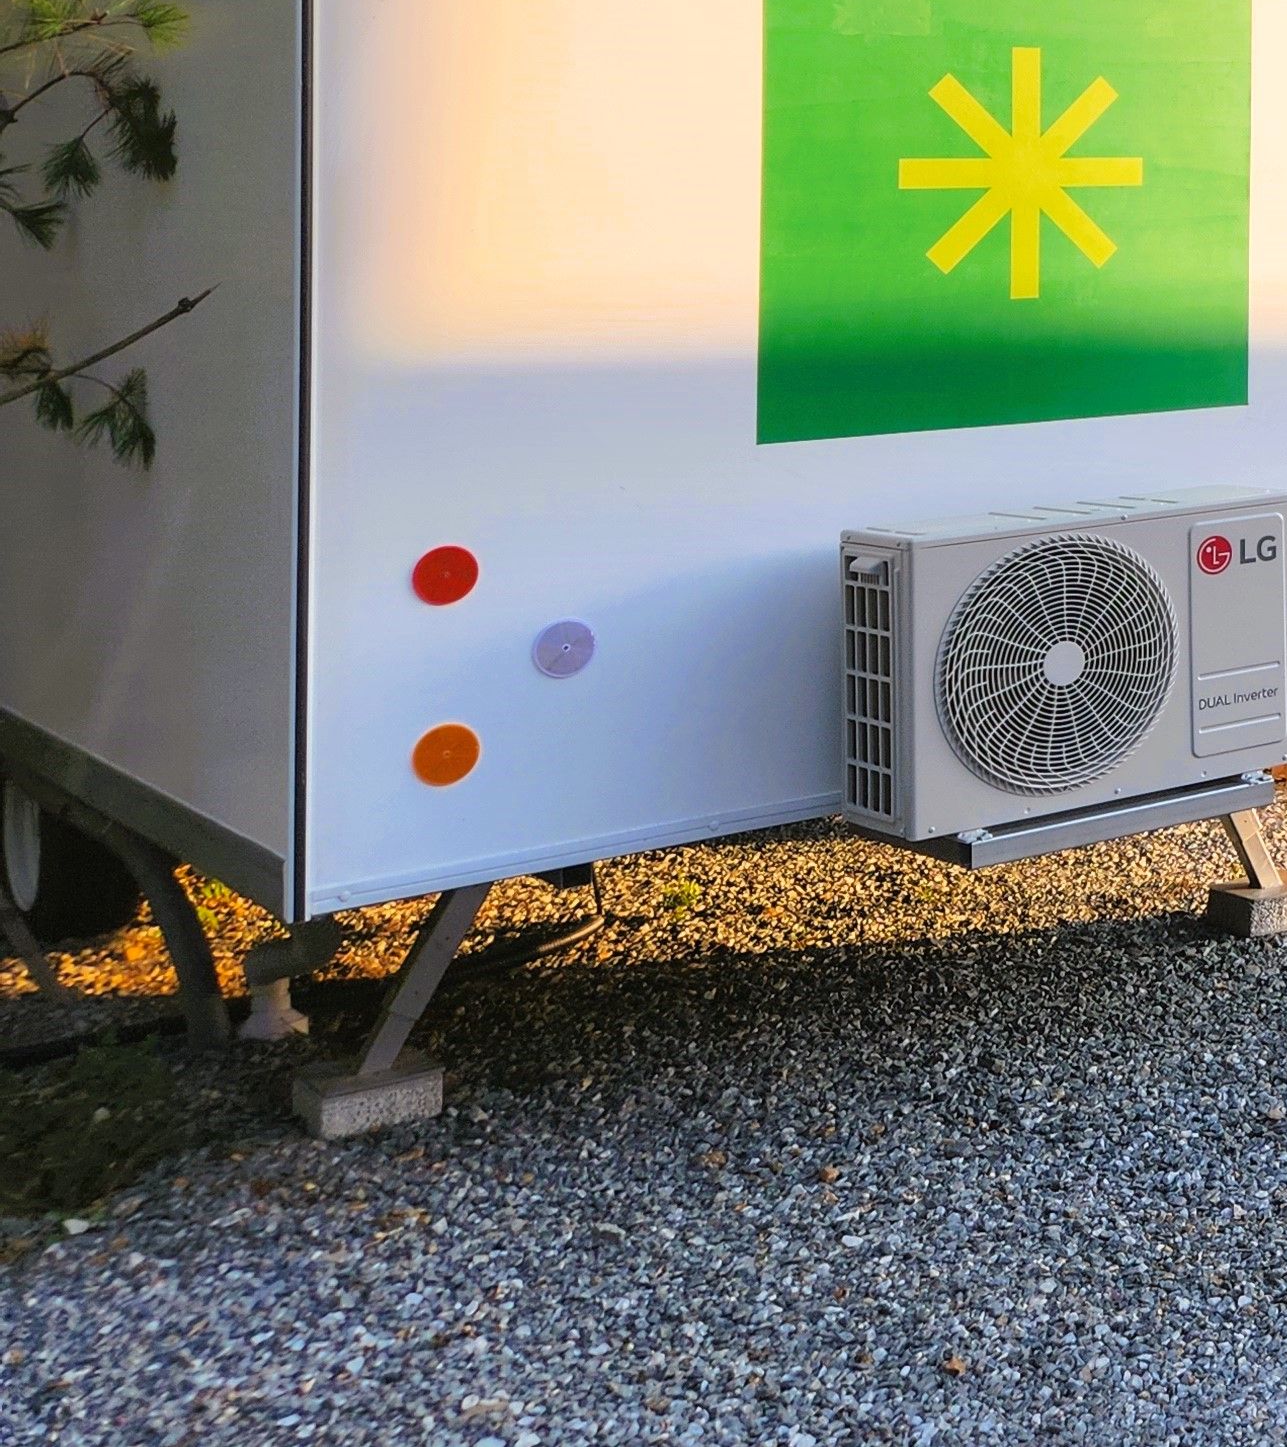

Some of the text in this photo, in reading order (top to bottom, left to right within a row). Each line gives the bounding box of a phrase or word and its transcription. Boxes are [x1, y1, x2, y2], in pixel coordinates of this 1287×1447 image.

[1240, 535, 1277, 564] LG
[1199, 688, 1278, 710] DUAL Inverter
